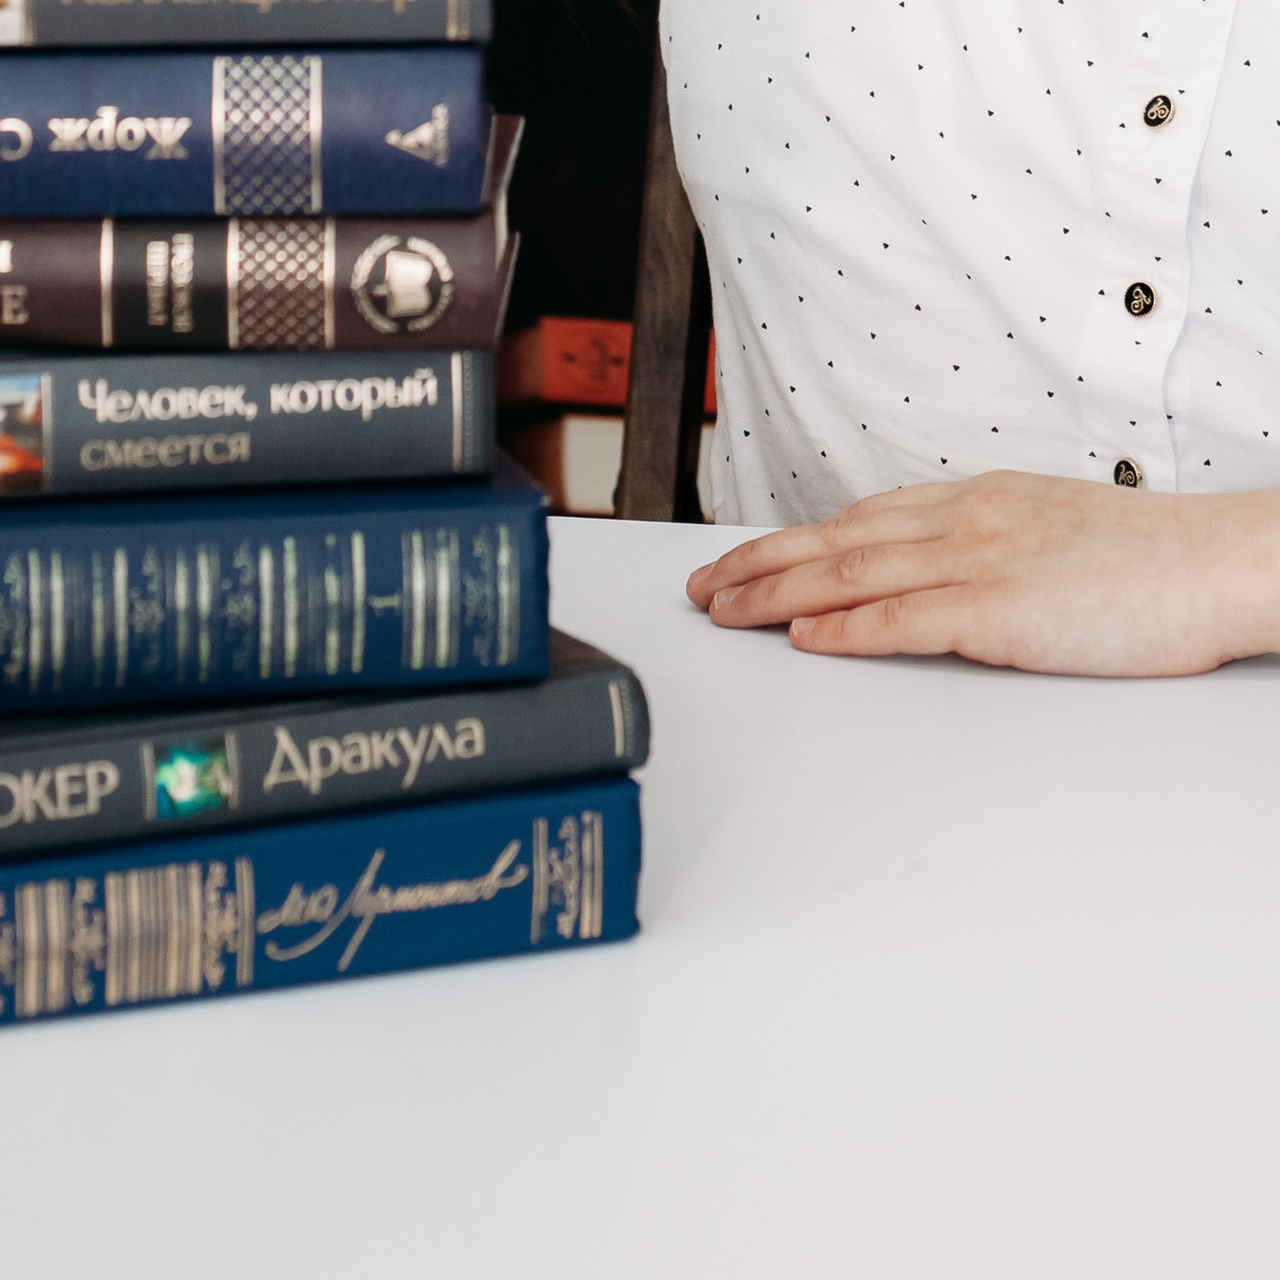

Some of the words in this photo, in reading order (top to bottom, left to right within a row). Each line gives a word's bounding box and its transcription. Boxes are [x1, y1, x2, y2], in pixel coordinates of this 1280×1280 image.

[47, 105, 193, 161] Жорж
[78, 378, 259, 425] Человек,
[269, 367, 439, 423] который
[79, 430, 252, 472] смеется
[262, 716, 487, 796] Дракула
